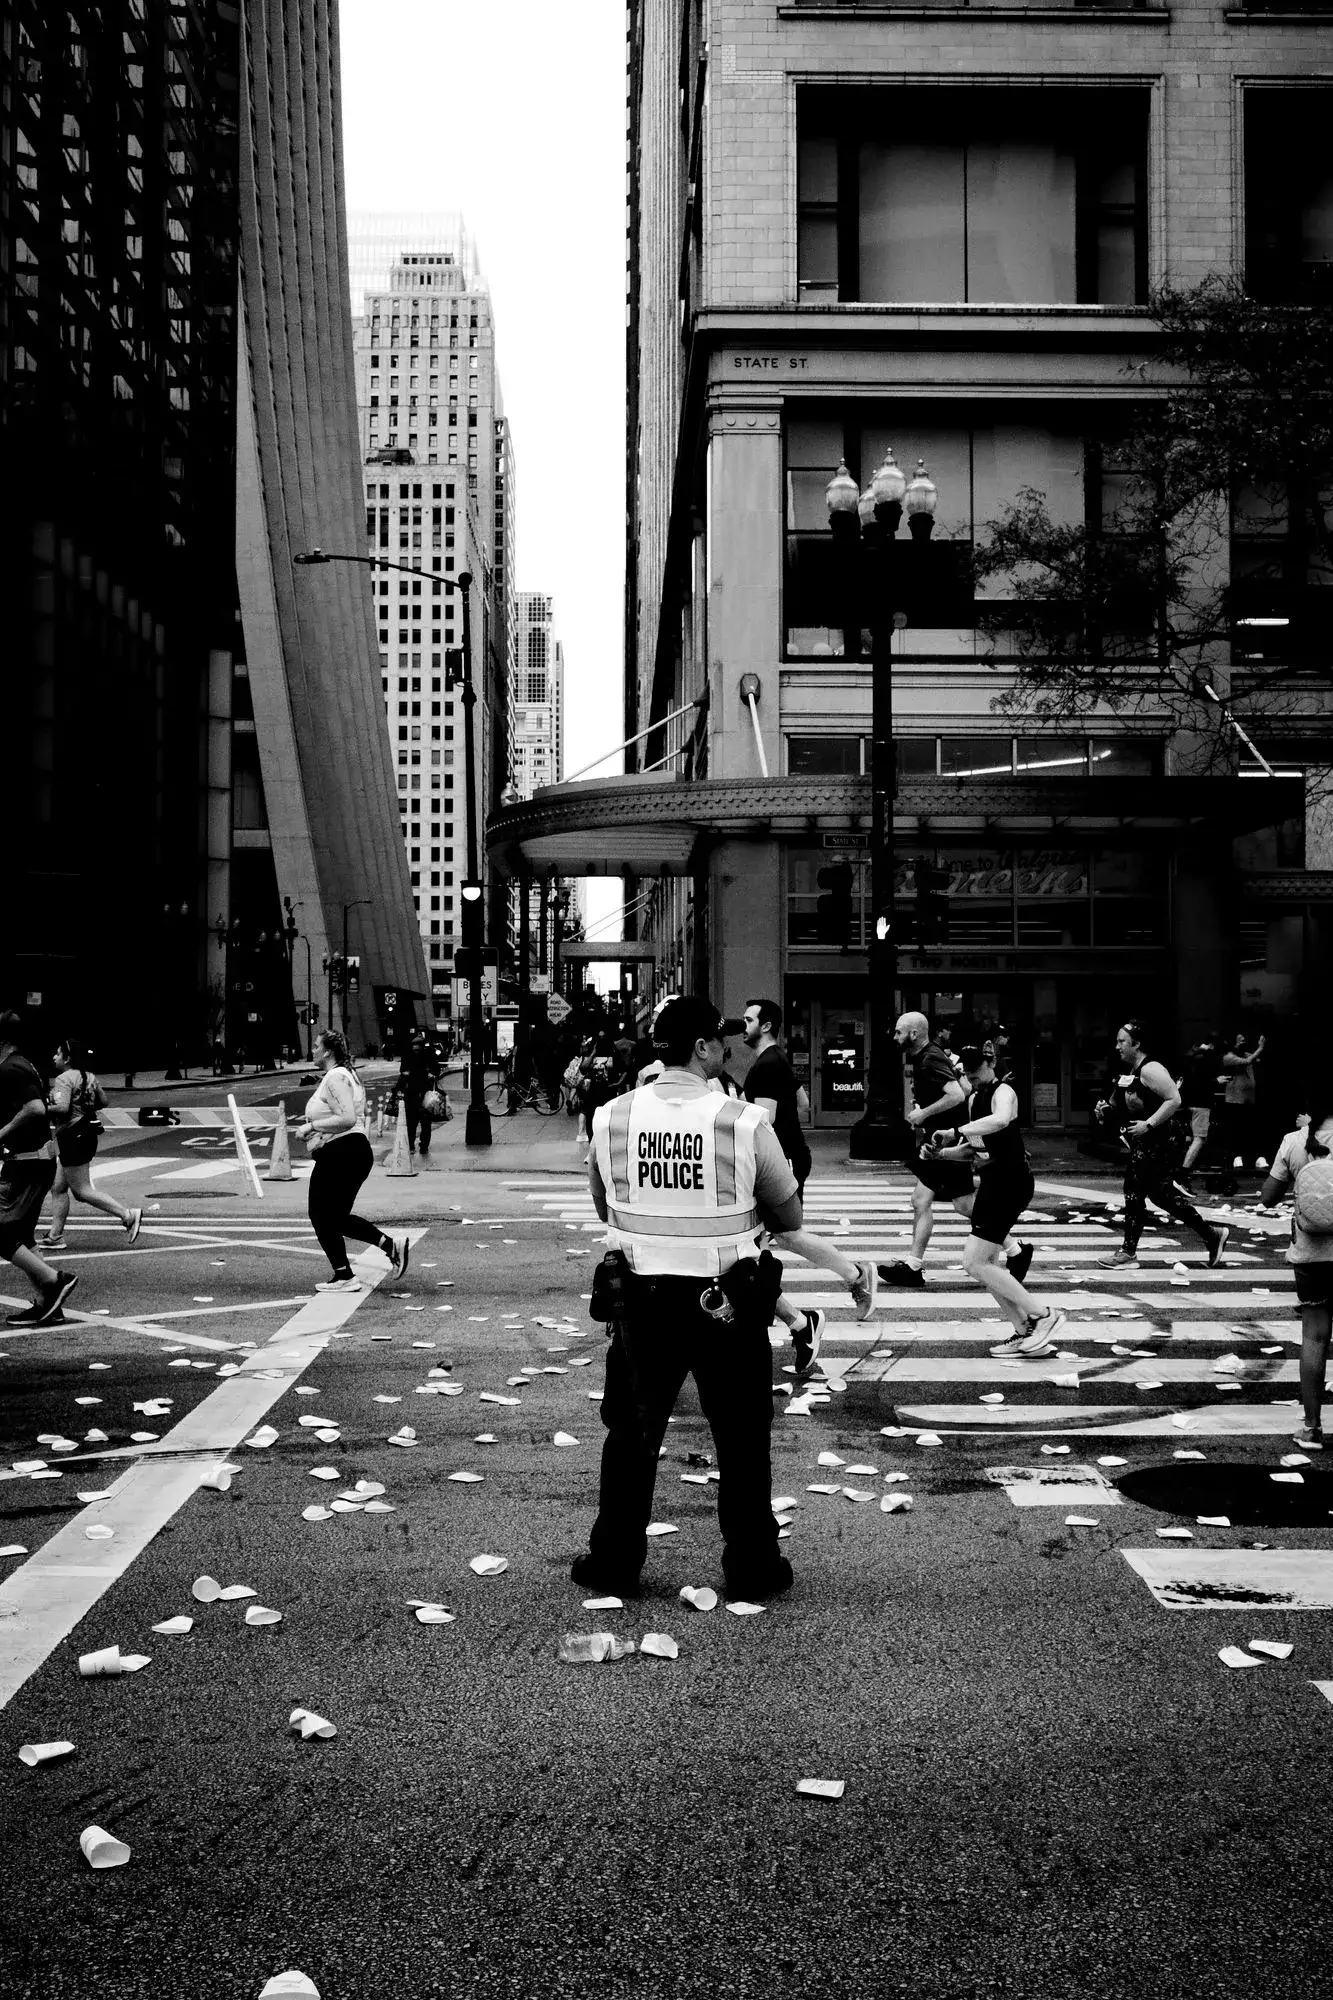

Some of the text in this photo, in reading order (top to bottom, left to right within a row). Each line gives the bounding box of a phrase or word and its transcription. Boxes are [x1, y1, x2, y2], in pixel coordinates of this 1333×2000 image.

[734, 357, 779, 368] STATE
[463, 980, 492, 989] BES
[638, 1132, 703, 1161] CHICAGO
[638, 1161, 704, 1190] POLICE
